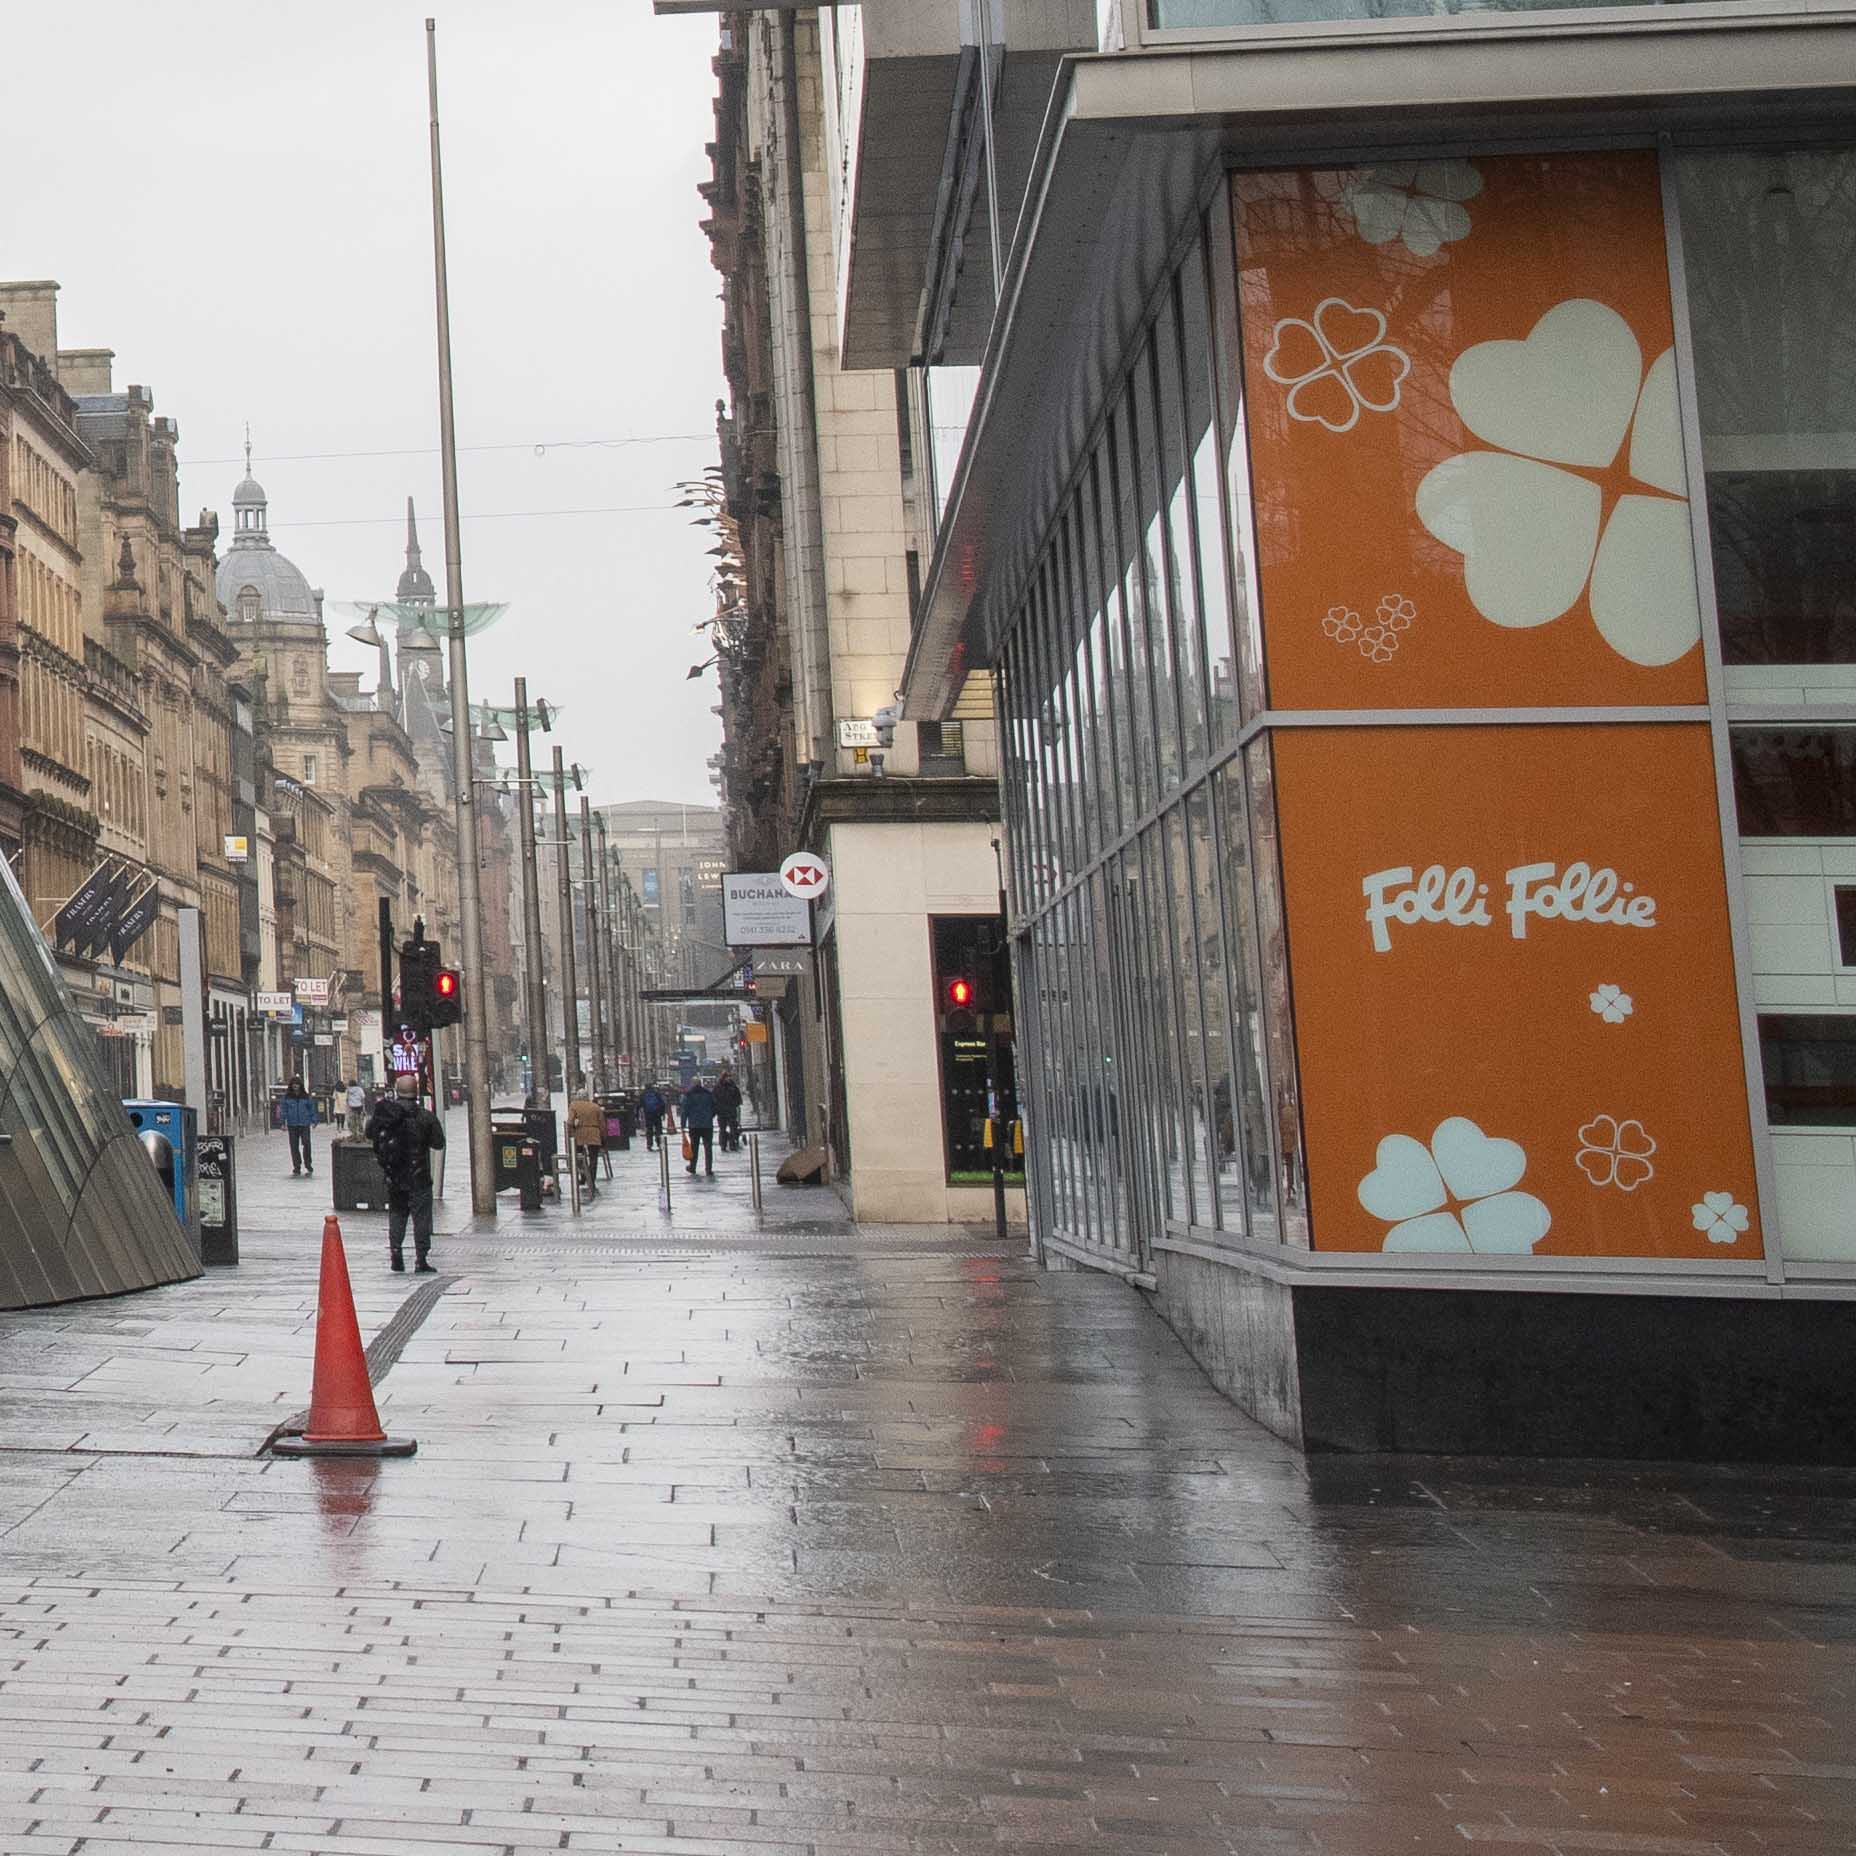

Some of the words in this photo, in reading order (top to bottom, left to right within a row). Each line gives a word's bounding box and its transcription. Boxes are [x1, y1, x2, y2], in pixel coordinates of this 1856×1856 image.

[730, 889, 793, 900] BUCHANA
[1362, 863, 1492, 953] Folli
[1505, 861, 1657, 940] Follie
[756, 961, 804, 970] ZARA
[310, 981, 327, 992] LET
[258, 996, 271, 1005] TO
[274, 996, 291, 1005] LET
